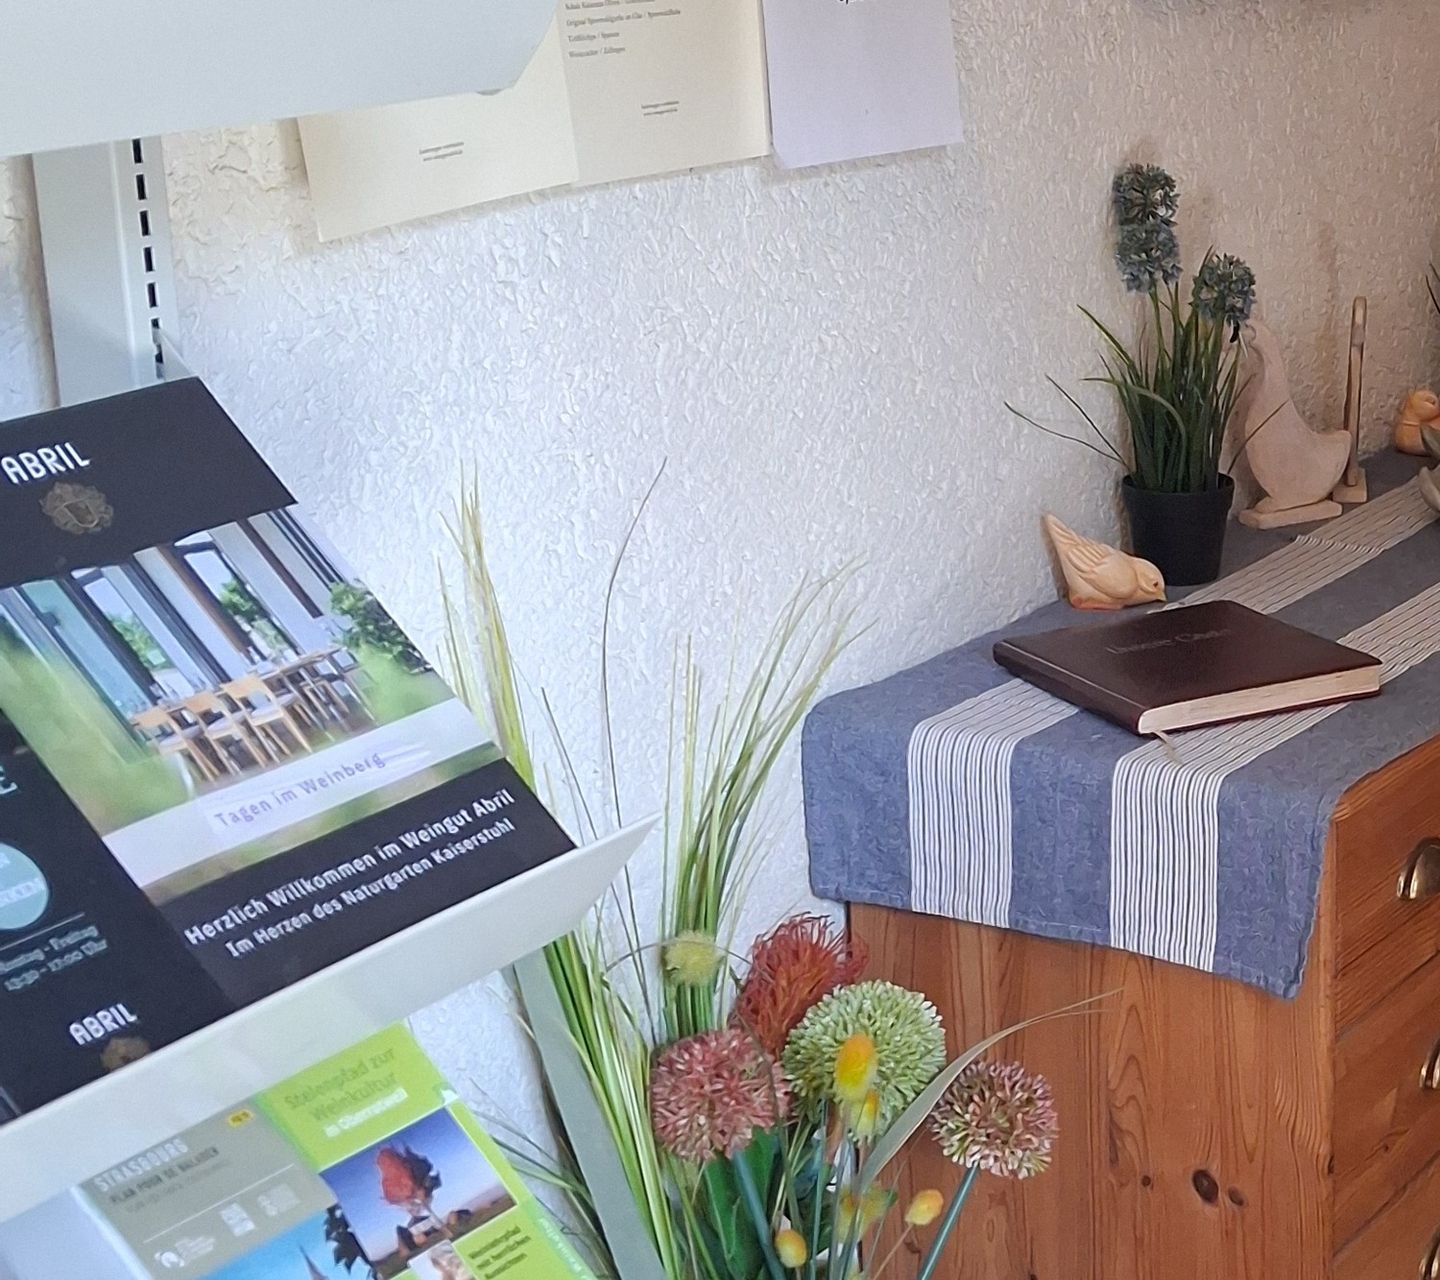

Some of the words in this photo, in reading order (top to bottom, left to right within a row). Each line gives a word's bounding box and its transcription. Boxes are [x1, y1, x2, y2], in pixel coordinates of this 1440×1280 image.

[1, 442, 91, 486] ABRIL
[213, 798, 273, 827] Tagen
[274, 787, 297, 807] im
[298, 751, 387, 796] Weinberg
[184, 899, 270, 945] Herzlich
[265, 852, 378, 909] Willkommen
[377, 843, 403, 863] im
[399, 808, 474, 851] Weingut
[471, 788, 517, 819] Abril
[225, 938, 256, 958] Im
[252, 913, 313, 945] Herzen
[312, 899, 344, 920] des
[339, 856, 434, 906] Naturgarten
[430, 817, 517, 866] Kaiserstuhl
[69, 1003, 138, 1046] ABRIL
[368, 1048, 394, 1070] zur
[94, 1137, 189, 1192] STRASBOURG
